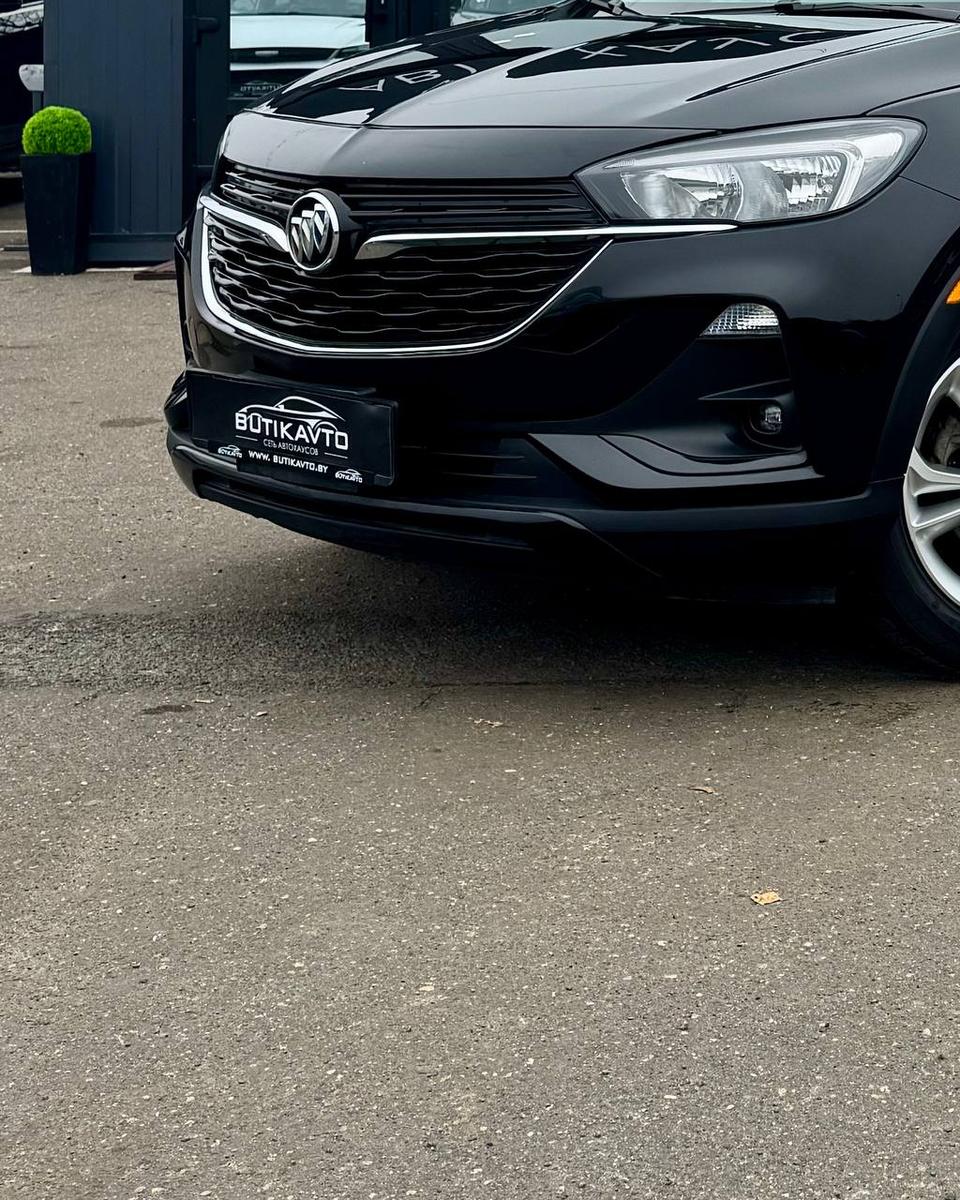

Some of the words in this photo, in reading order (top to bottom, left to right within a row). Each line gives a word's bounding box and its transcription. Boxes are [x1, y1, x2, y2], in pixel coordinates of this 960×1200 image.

[235, 412, 348, 450] BUTIKAVTO
[263, 439, 277, 449] СЕТЬ
[278, 441, 318, 455] АВТОХАУСОВ
[273, 455, 328, 473] BUTIKAVTO.BY
